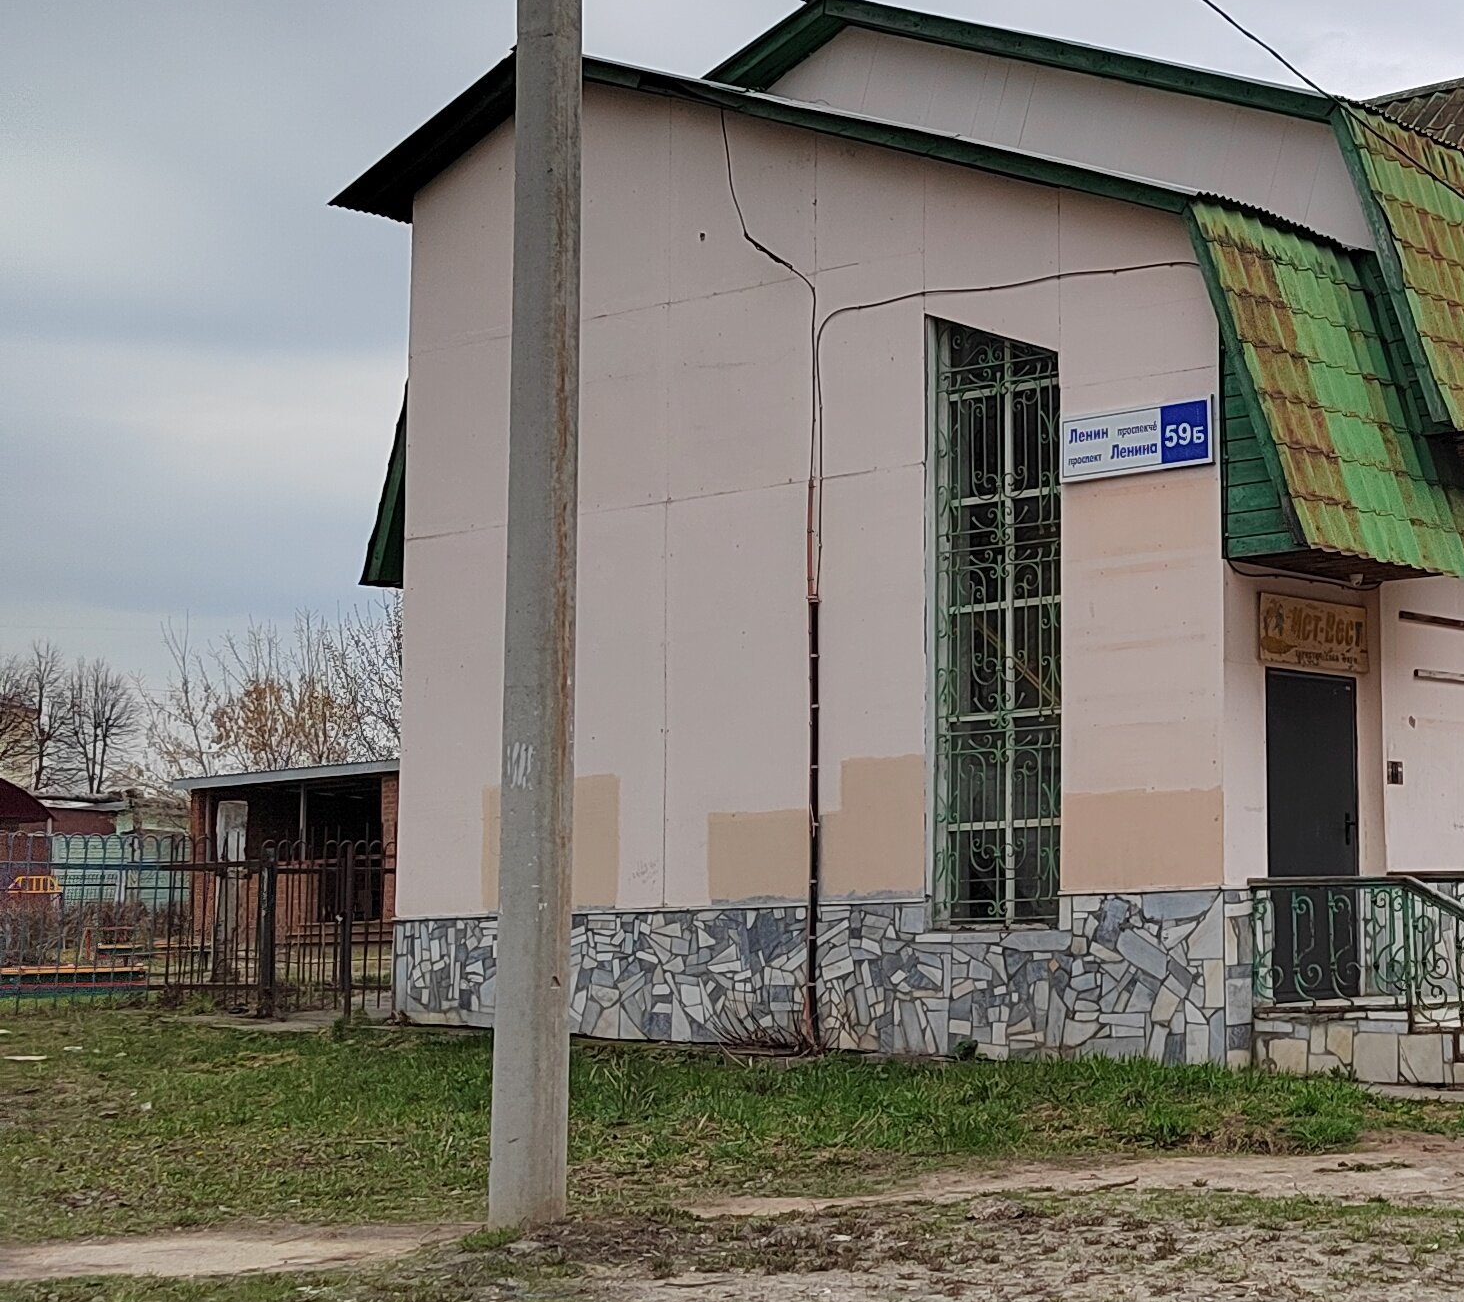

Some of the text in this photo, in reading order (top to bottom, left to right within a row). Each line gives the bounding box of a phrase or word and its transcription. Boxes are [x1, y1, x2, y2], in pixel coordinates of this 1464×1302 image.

[1068, 427, 1109, 445] Ленин
[1164, 422, 1205, 448] 59Б
[1068, 442, 1158, 468] проспект Ленина
